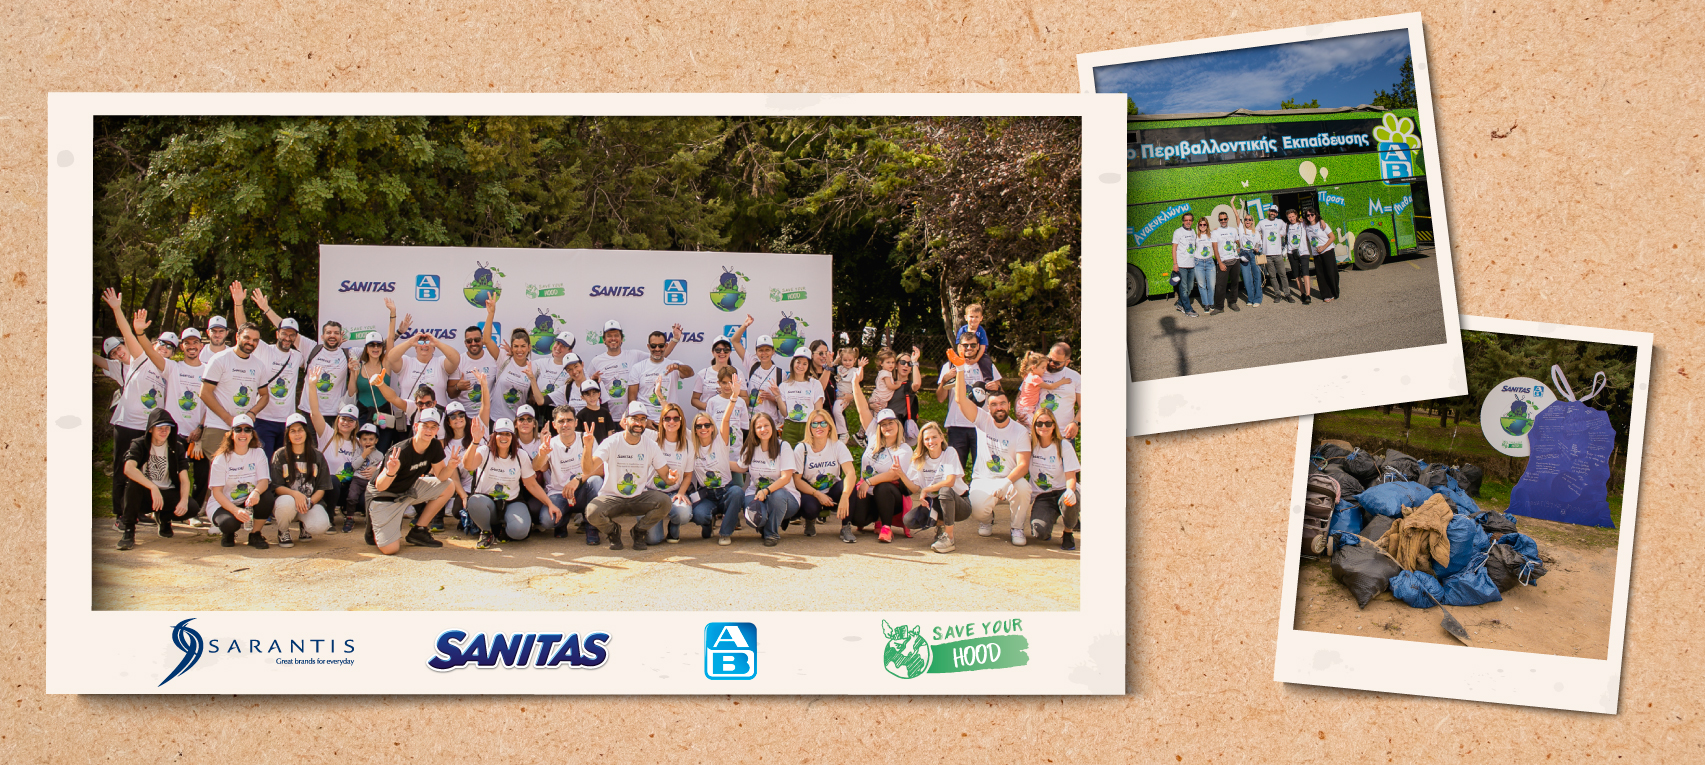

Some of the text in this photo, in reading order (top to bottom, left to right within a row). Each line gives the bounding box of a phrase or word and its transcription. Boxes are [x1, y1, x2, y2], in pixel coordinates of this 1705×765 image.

[1141, 136, 1277, 160] Περιβαλλοντικής
[1281, 132, 1370, 150] Εκπαίδευσης
[1134, 203, 1190, 246] Ανακυκλώνω
[338, 280, 396, 293] SANITAS
[589, 285, 645, 297] SANITAS
[1501, 385, 1531, 394] SANITAS
[808, 460, 836, 469] SANITAS
